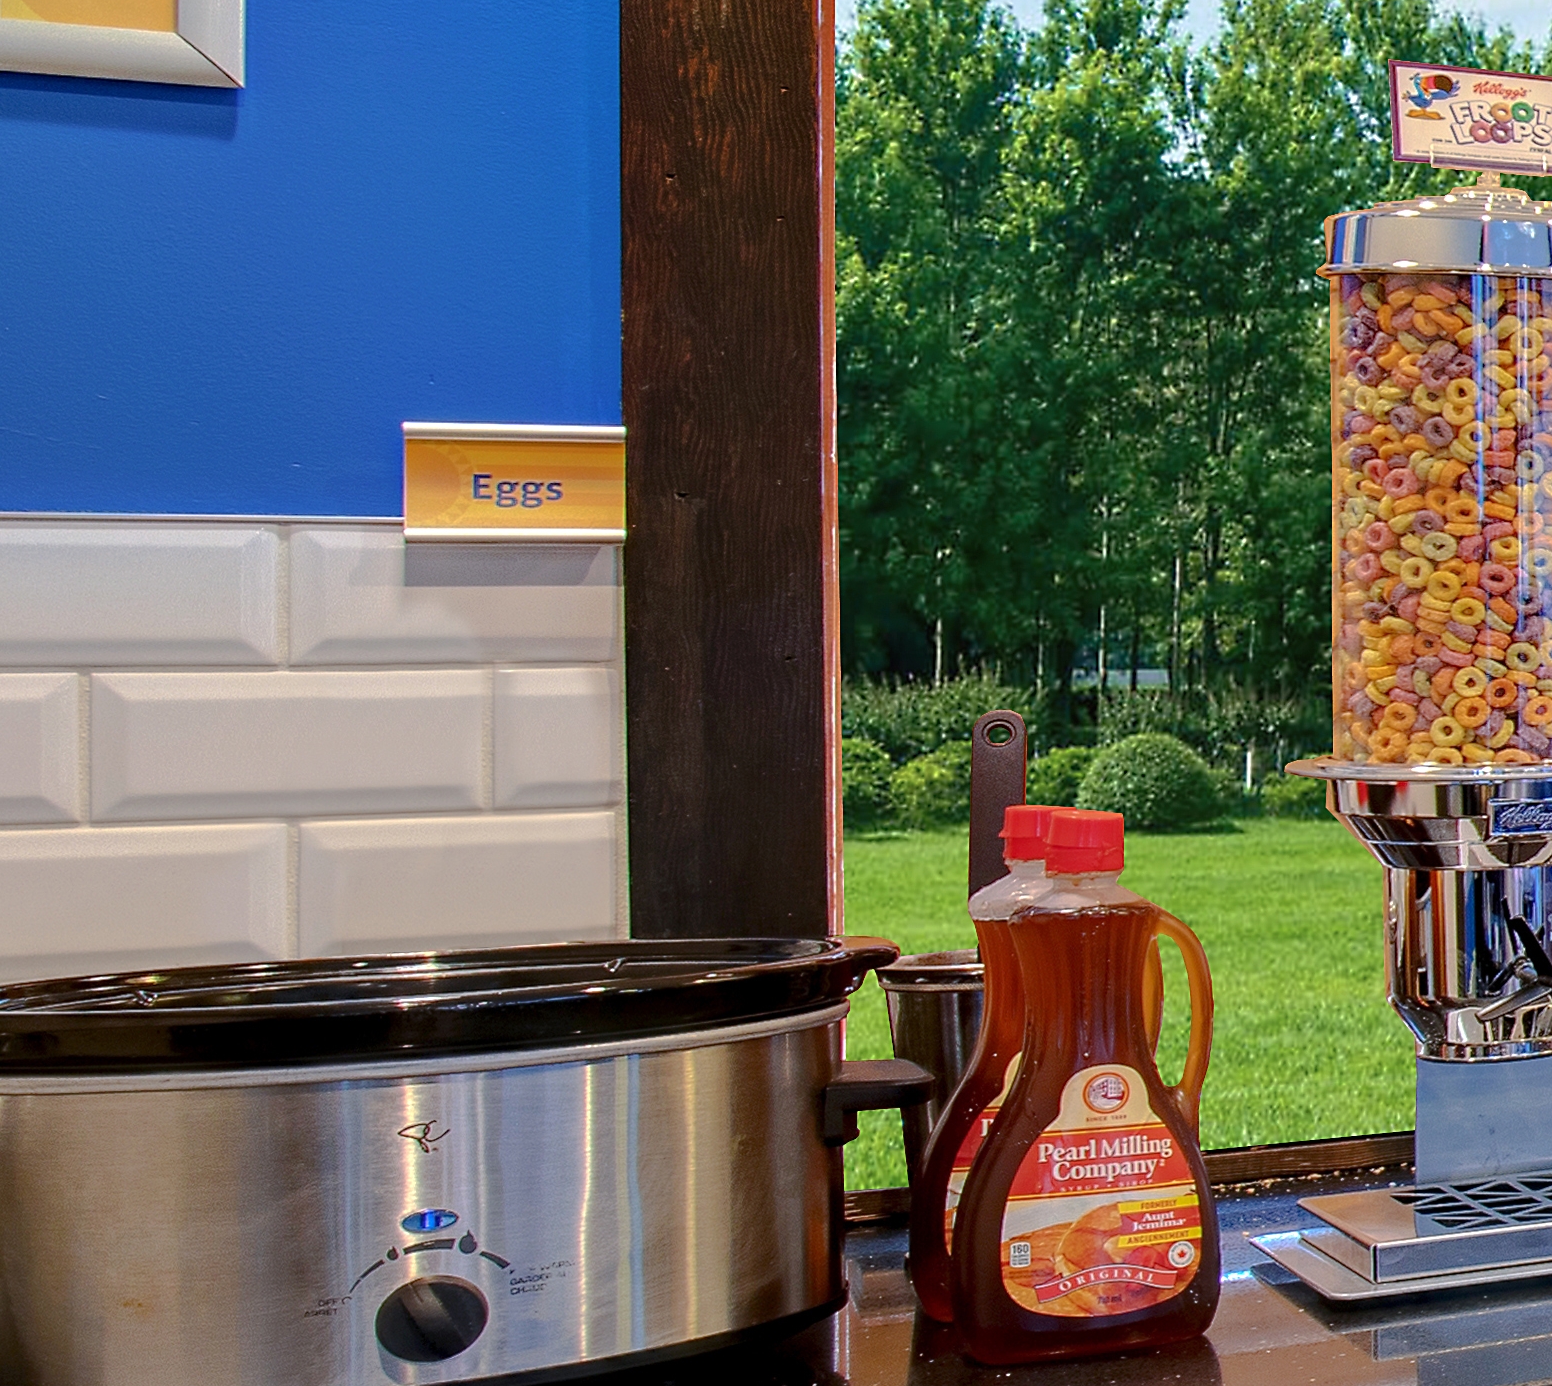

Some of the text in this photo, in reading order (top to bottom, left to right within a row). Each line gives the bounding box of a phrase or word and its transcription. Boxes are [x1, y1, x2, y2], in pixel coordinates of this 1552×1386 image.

[1473, 80, 1529, 101] Kellogg's
[1450, 100, 1552, 124] FROOT
[1451, 121, 1552, 146] LOOPS
[472, 474, 563, 508] Eggs
[1038, 1134, 1173, 1163] Pearl Milling
[1053, 1158, 1160, 1182] Company
[1132, 1218, 1186, 1231] Jemima
[1142, 1211, 1174, 1222] Aunt
[1058, 1269, 1154, 1292] ORIGINAL
